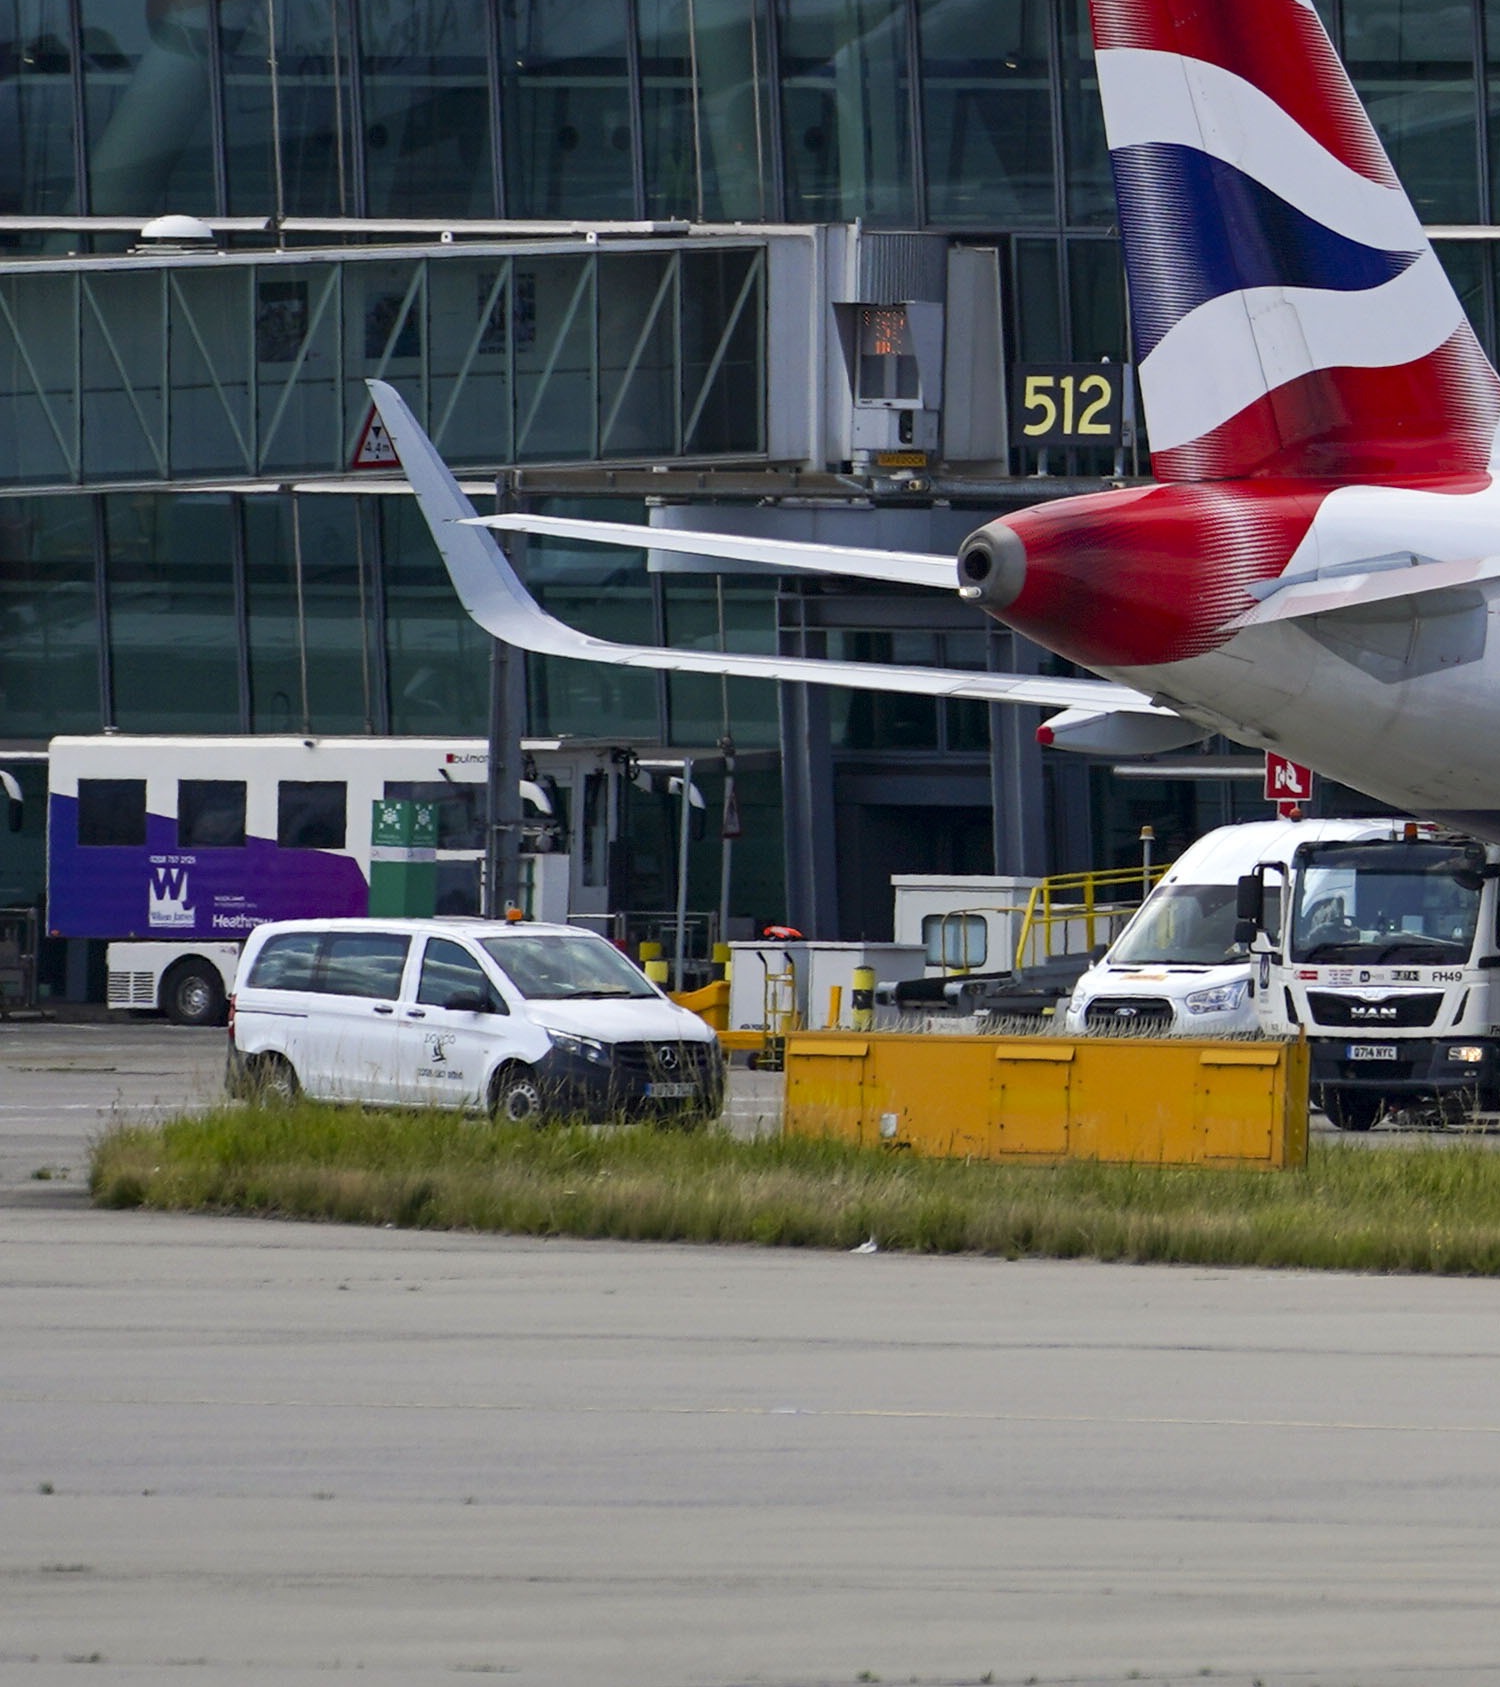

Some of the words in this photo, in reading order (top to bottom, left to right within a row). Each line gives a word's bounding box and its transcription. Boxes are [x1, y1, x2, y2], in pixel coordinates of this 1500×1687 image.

[1022, 374, 1113, 436] 512
[1432, 971, 1463, 982] FH49
[1350, 1007, 1397, 1019] MAN
